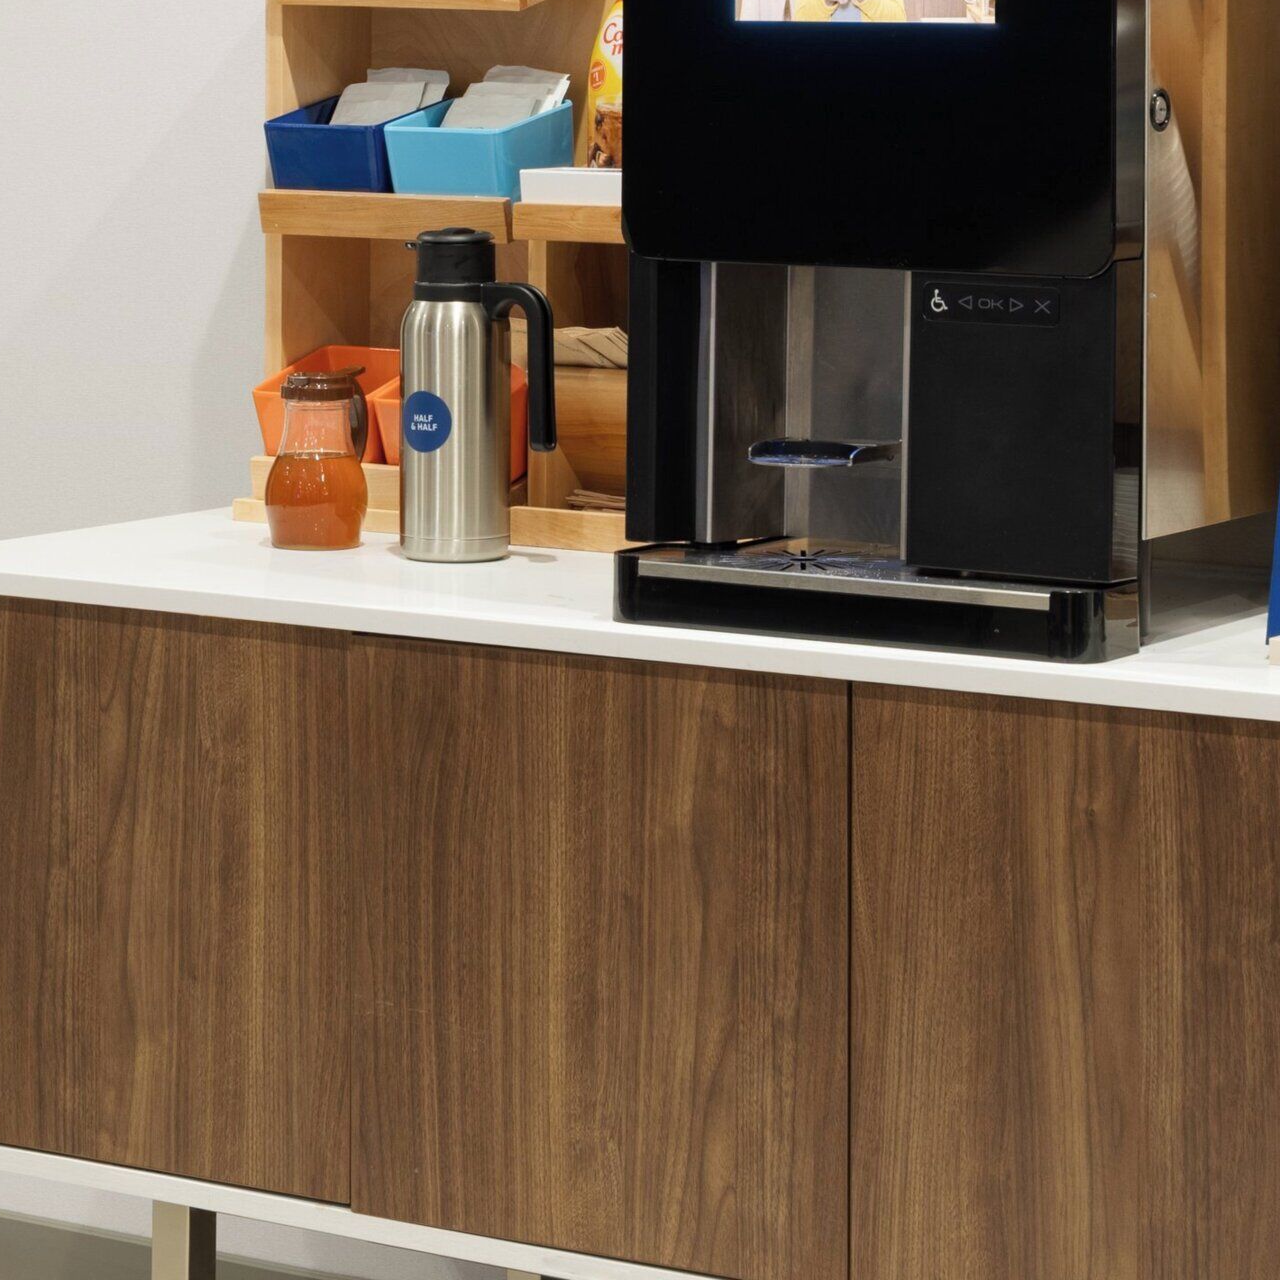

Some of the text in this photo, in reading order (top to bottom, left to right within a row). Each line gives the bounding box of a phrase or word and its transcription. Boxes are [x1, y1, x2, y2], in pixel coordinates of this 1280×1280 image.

[978, 298, 1004, 310] OK
[413, 414, 433, 423] HALF
[410, 422, 438, 431] & HALF
